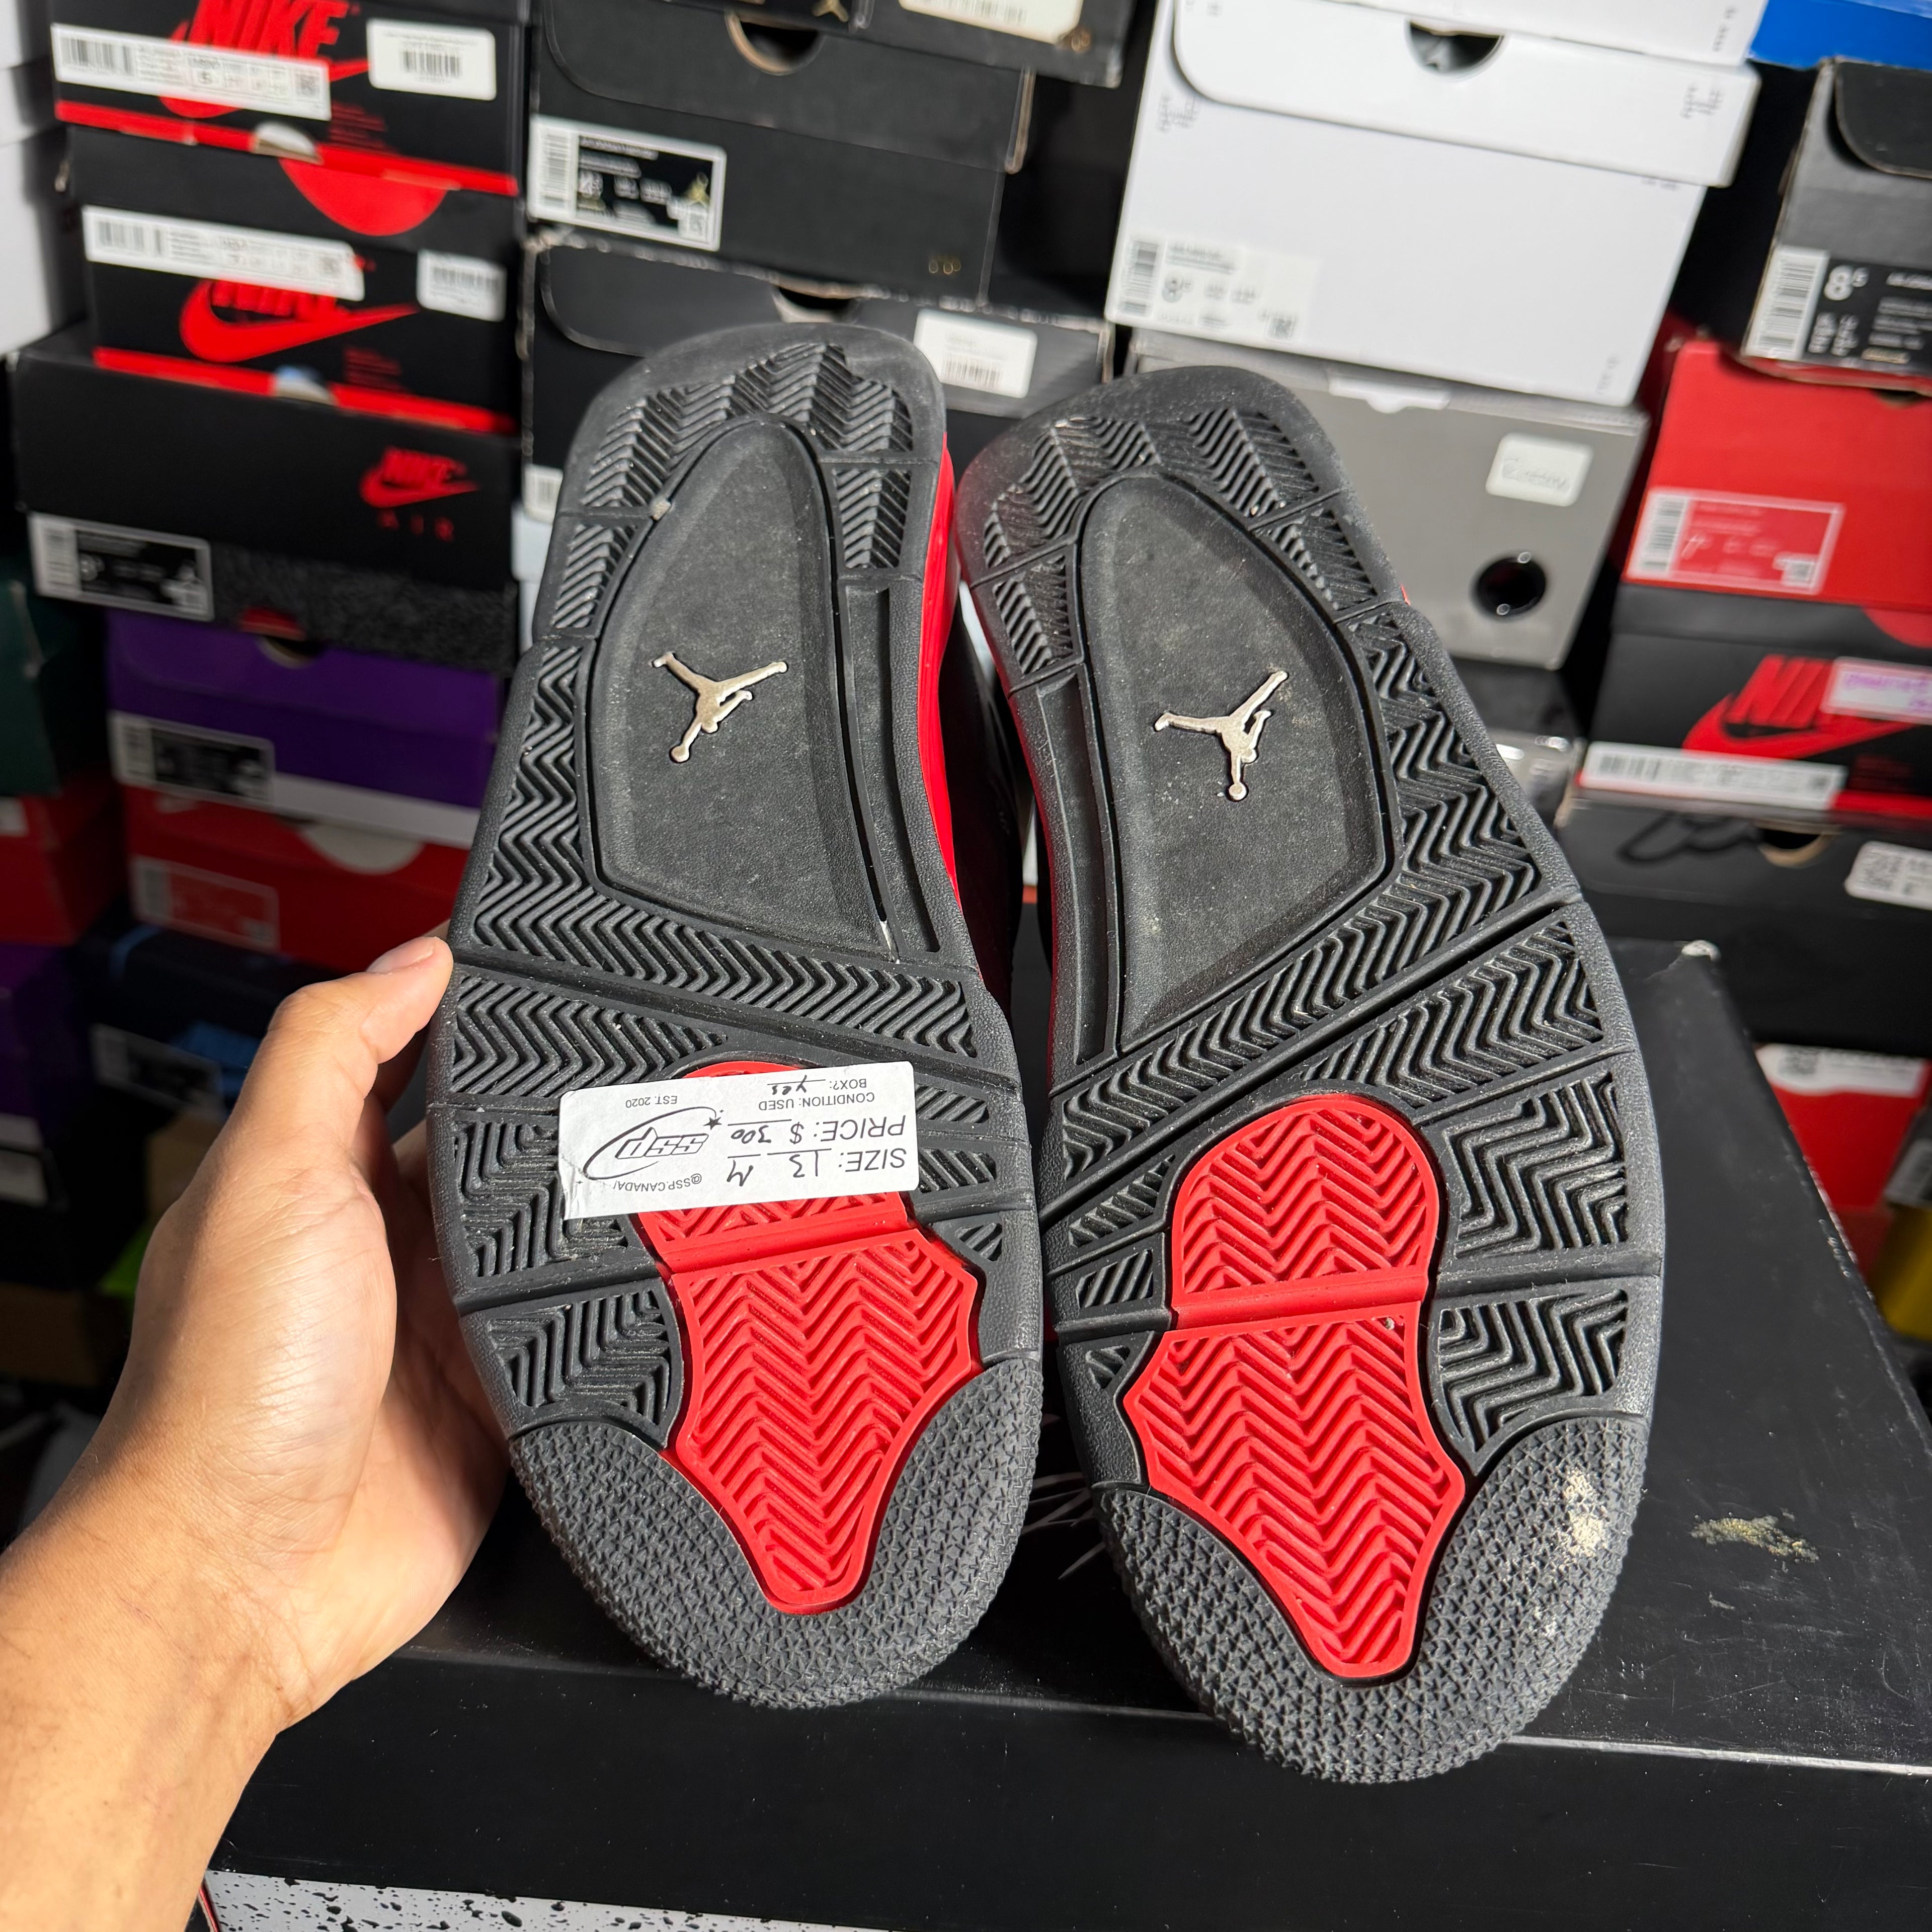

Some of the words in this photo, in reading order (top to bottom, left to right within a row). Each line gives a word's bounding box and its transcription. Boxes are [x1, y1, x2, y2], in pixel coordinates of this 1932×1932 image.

[829, 1078, 866, 1091] BOX?:
[625, 1097, 651, 1108] 2020
[652, 1096, 678, 1105] EST.
[759, 1099, 794, 1110] USED
[797, 1092, 875, 1108] CONDITION:
[731, 1125, 772, 1144] 300
[813, 1115, 906, 1142] PRICE:
[789, 1151, 819, 1178] 13
[839, 1148, 907, 1172] SIZE:
